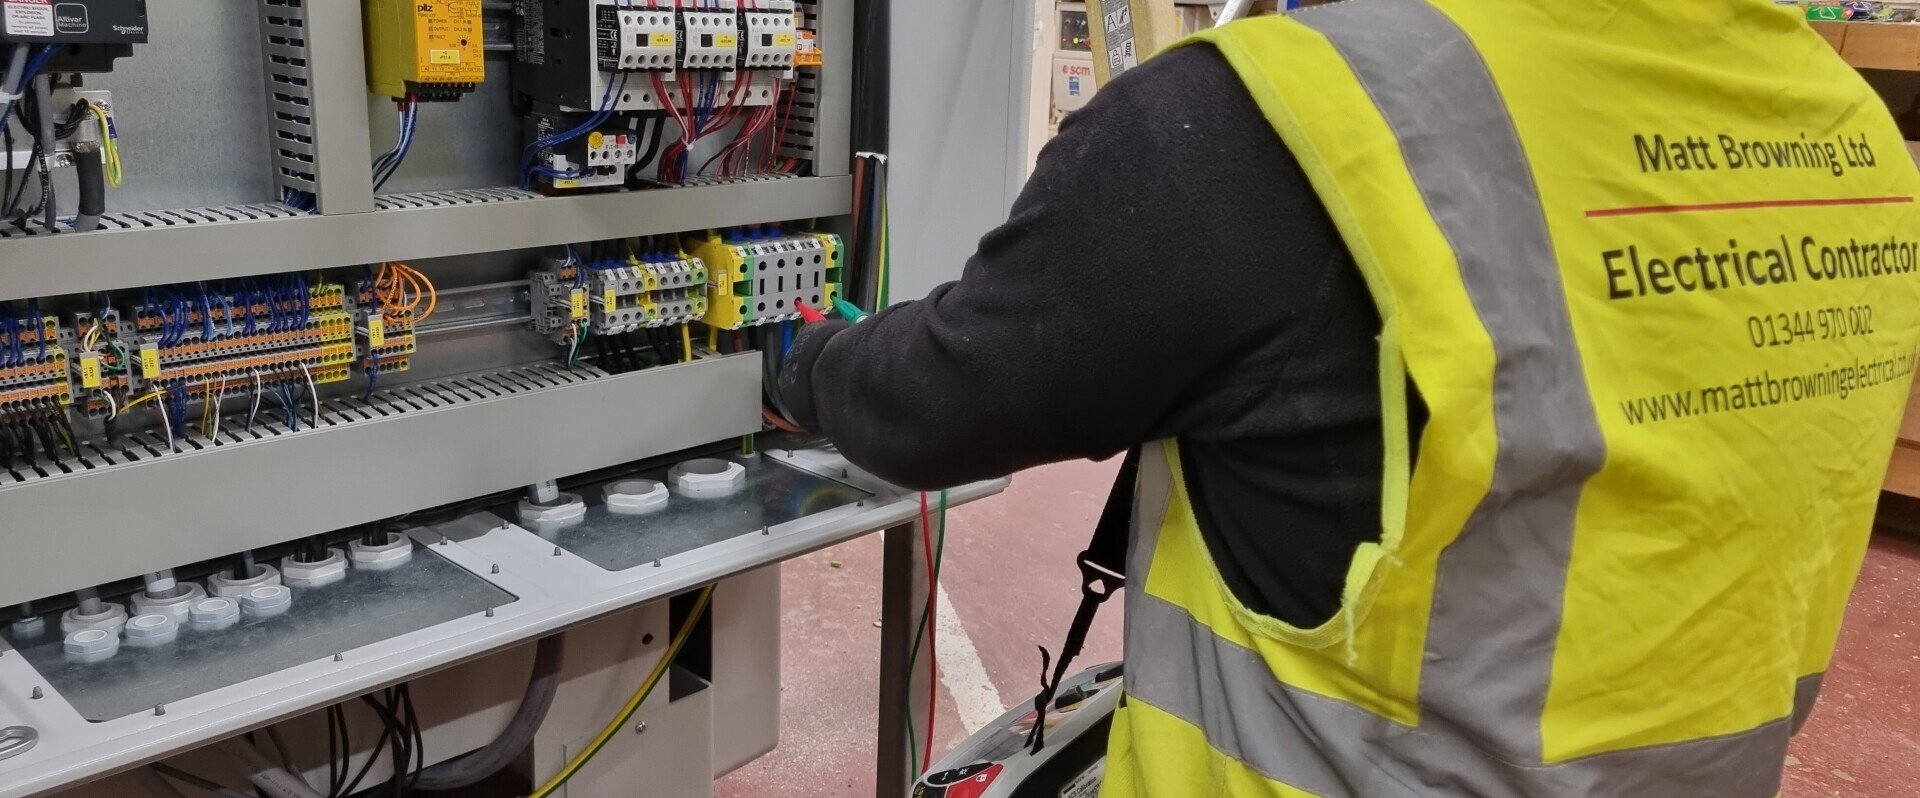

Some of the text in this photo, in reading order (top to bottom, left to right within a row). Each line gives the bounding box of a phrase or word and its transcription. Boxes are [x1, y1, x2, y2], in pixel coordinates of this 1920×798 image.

[417, 3, 433, 12] pilz
[57, 15, 82, 23] Altivar
[112, 24, 144, 32] Schneider
[1070, 65, 1091, 76] scm
[1633, 132, 1877, 177] Matt Browning Ltd
[1602, 234, 1919, 300] Electrical Contractor
[1747, 304, 1874, 349] 01344 970 002
